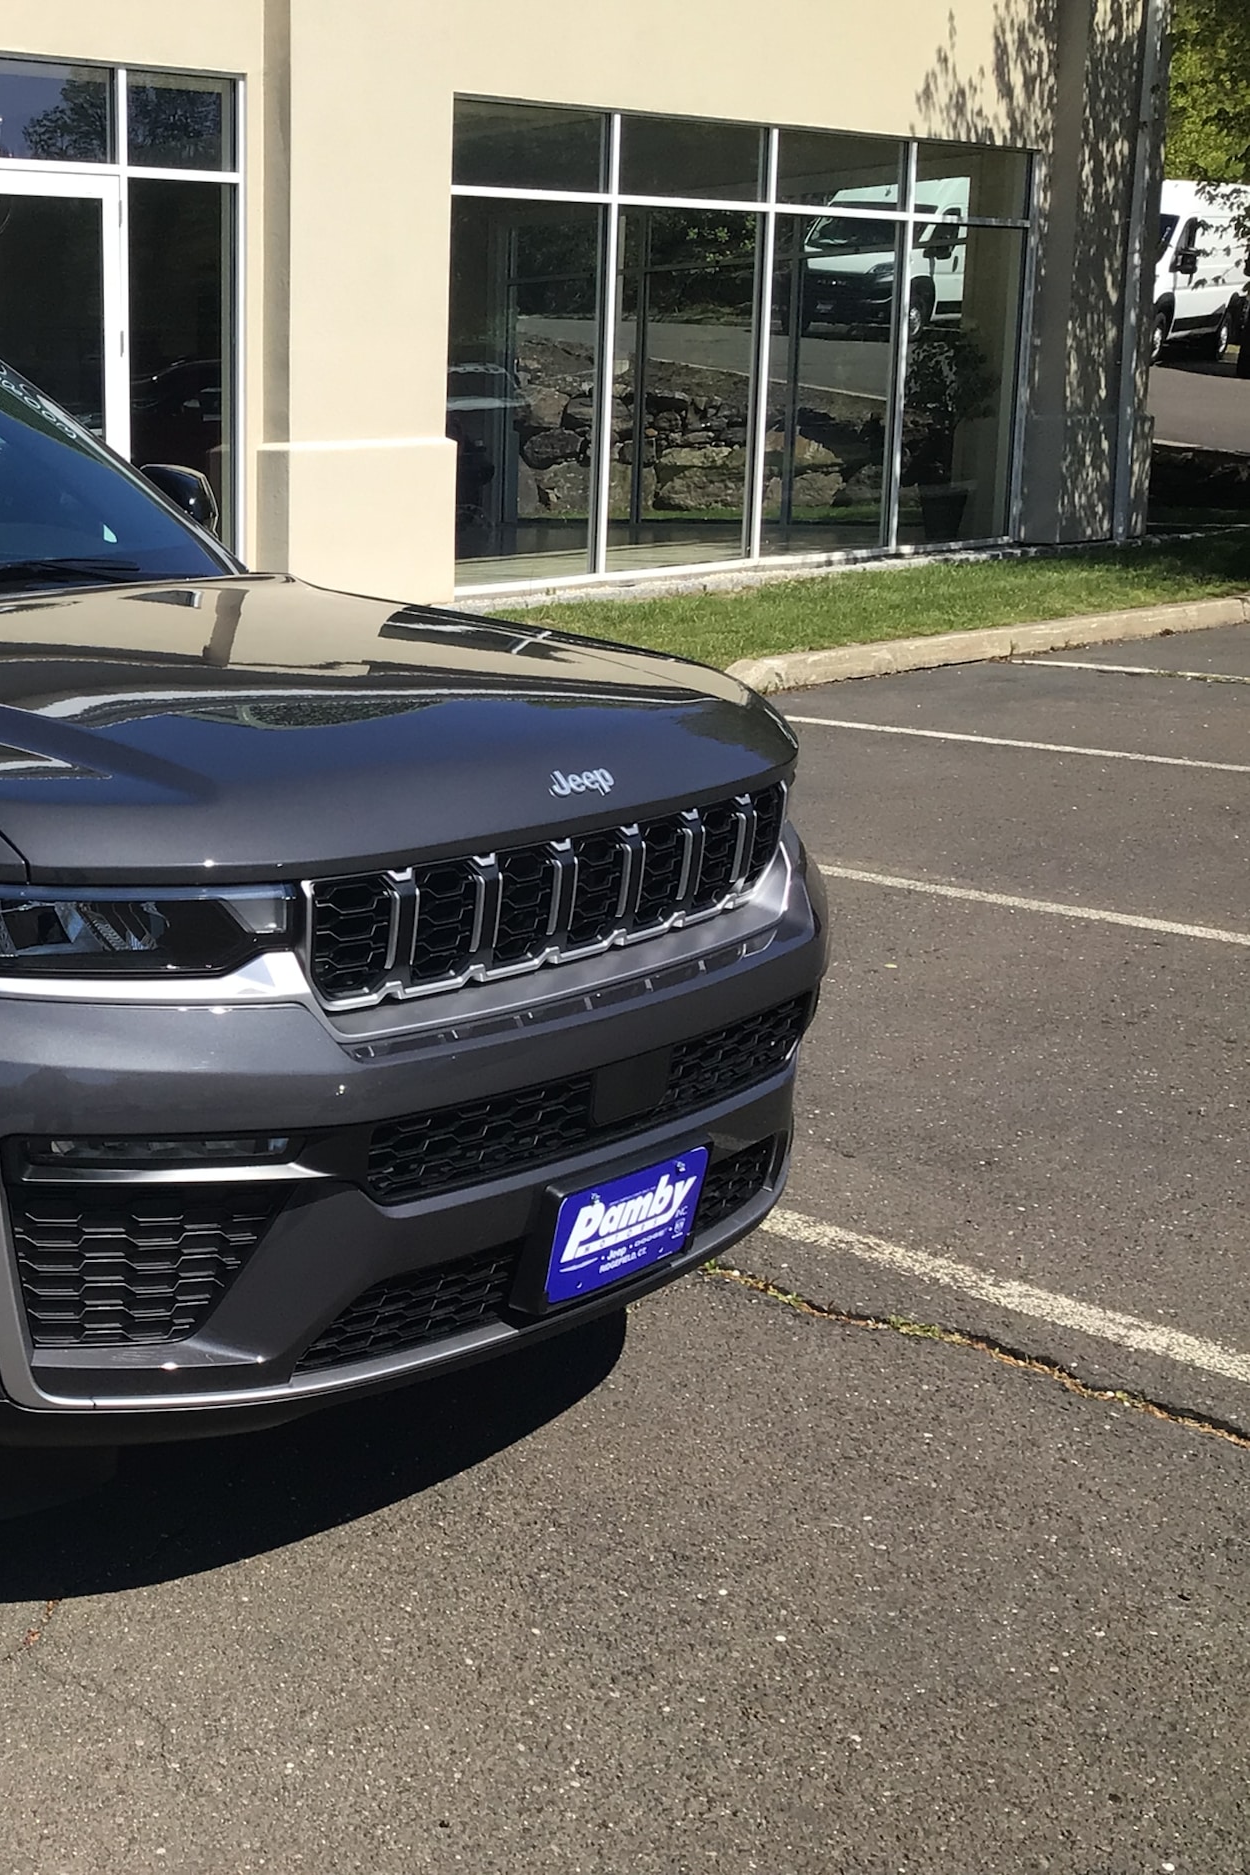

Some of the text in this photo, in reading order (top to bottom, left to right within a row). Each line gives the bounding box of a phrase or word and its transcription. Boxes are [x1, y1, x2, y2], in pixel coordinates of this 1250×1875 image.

[549, 767, 615, 797] Jeep
[560, 1174, 697, 1263] Pamby
[607, 1246, 627, 1261] Jeep
